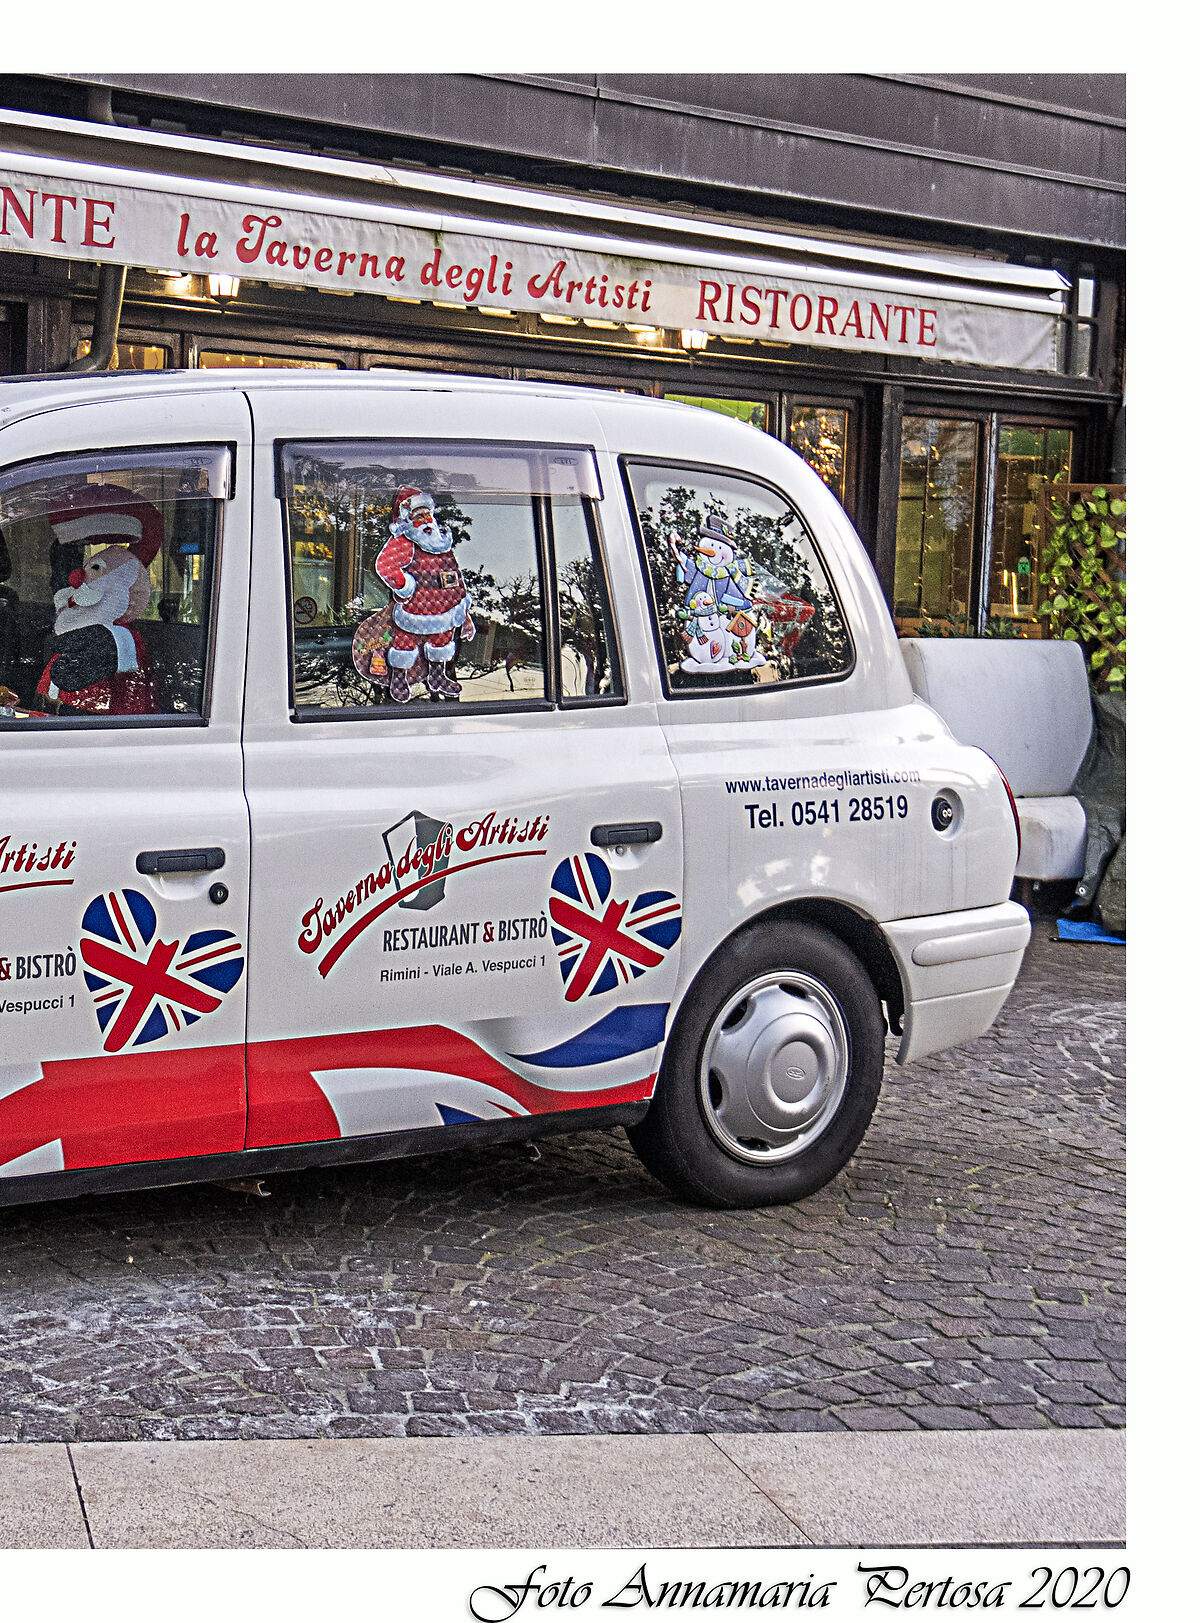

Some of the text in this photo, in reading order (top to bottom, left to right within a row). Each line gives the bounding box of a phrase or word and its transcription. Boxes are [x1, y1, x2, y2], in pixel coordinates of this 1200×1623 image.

[178, 214, 651, 312] la Taverna degli Artisti
[696, 280, 936, 346] RISTORANTE
[725, 768, 920, 793] www.tavernadegliartisti.com
[745, 795, 907, 828] Tel. 0541 28519
[298, 810, 550, 955] Taverna degli Artisti
[384, 911, 547, 952] RESTAURANT & BISTRÒ
[16, 946, 76, 979] BISTRÒ
[381, 966, 420, 982] Rimini
[433, 963, 462, 976] Viale
[465, 962, 478, 974] A.
[482, 956, 535, 973] Vespucci
[540, 955, 546, 967] 1
[69, 995, 74, 1007] 1
